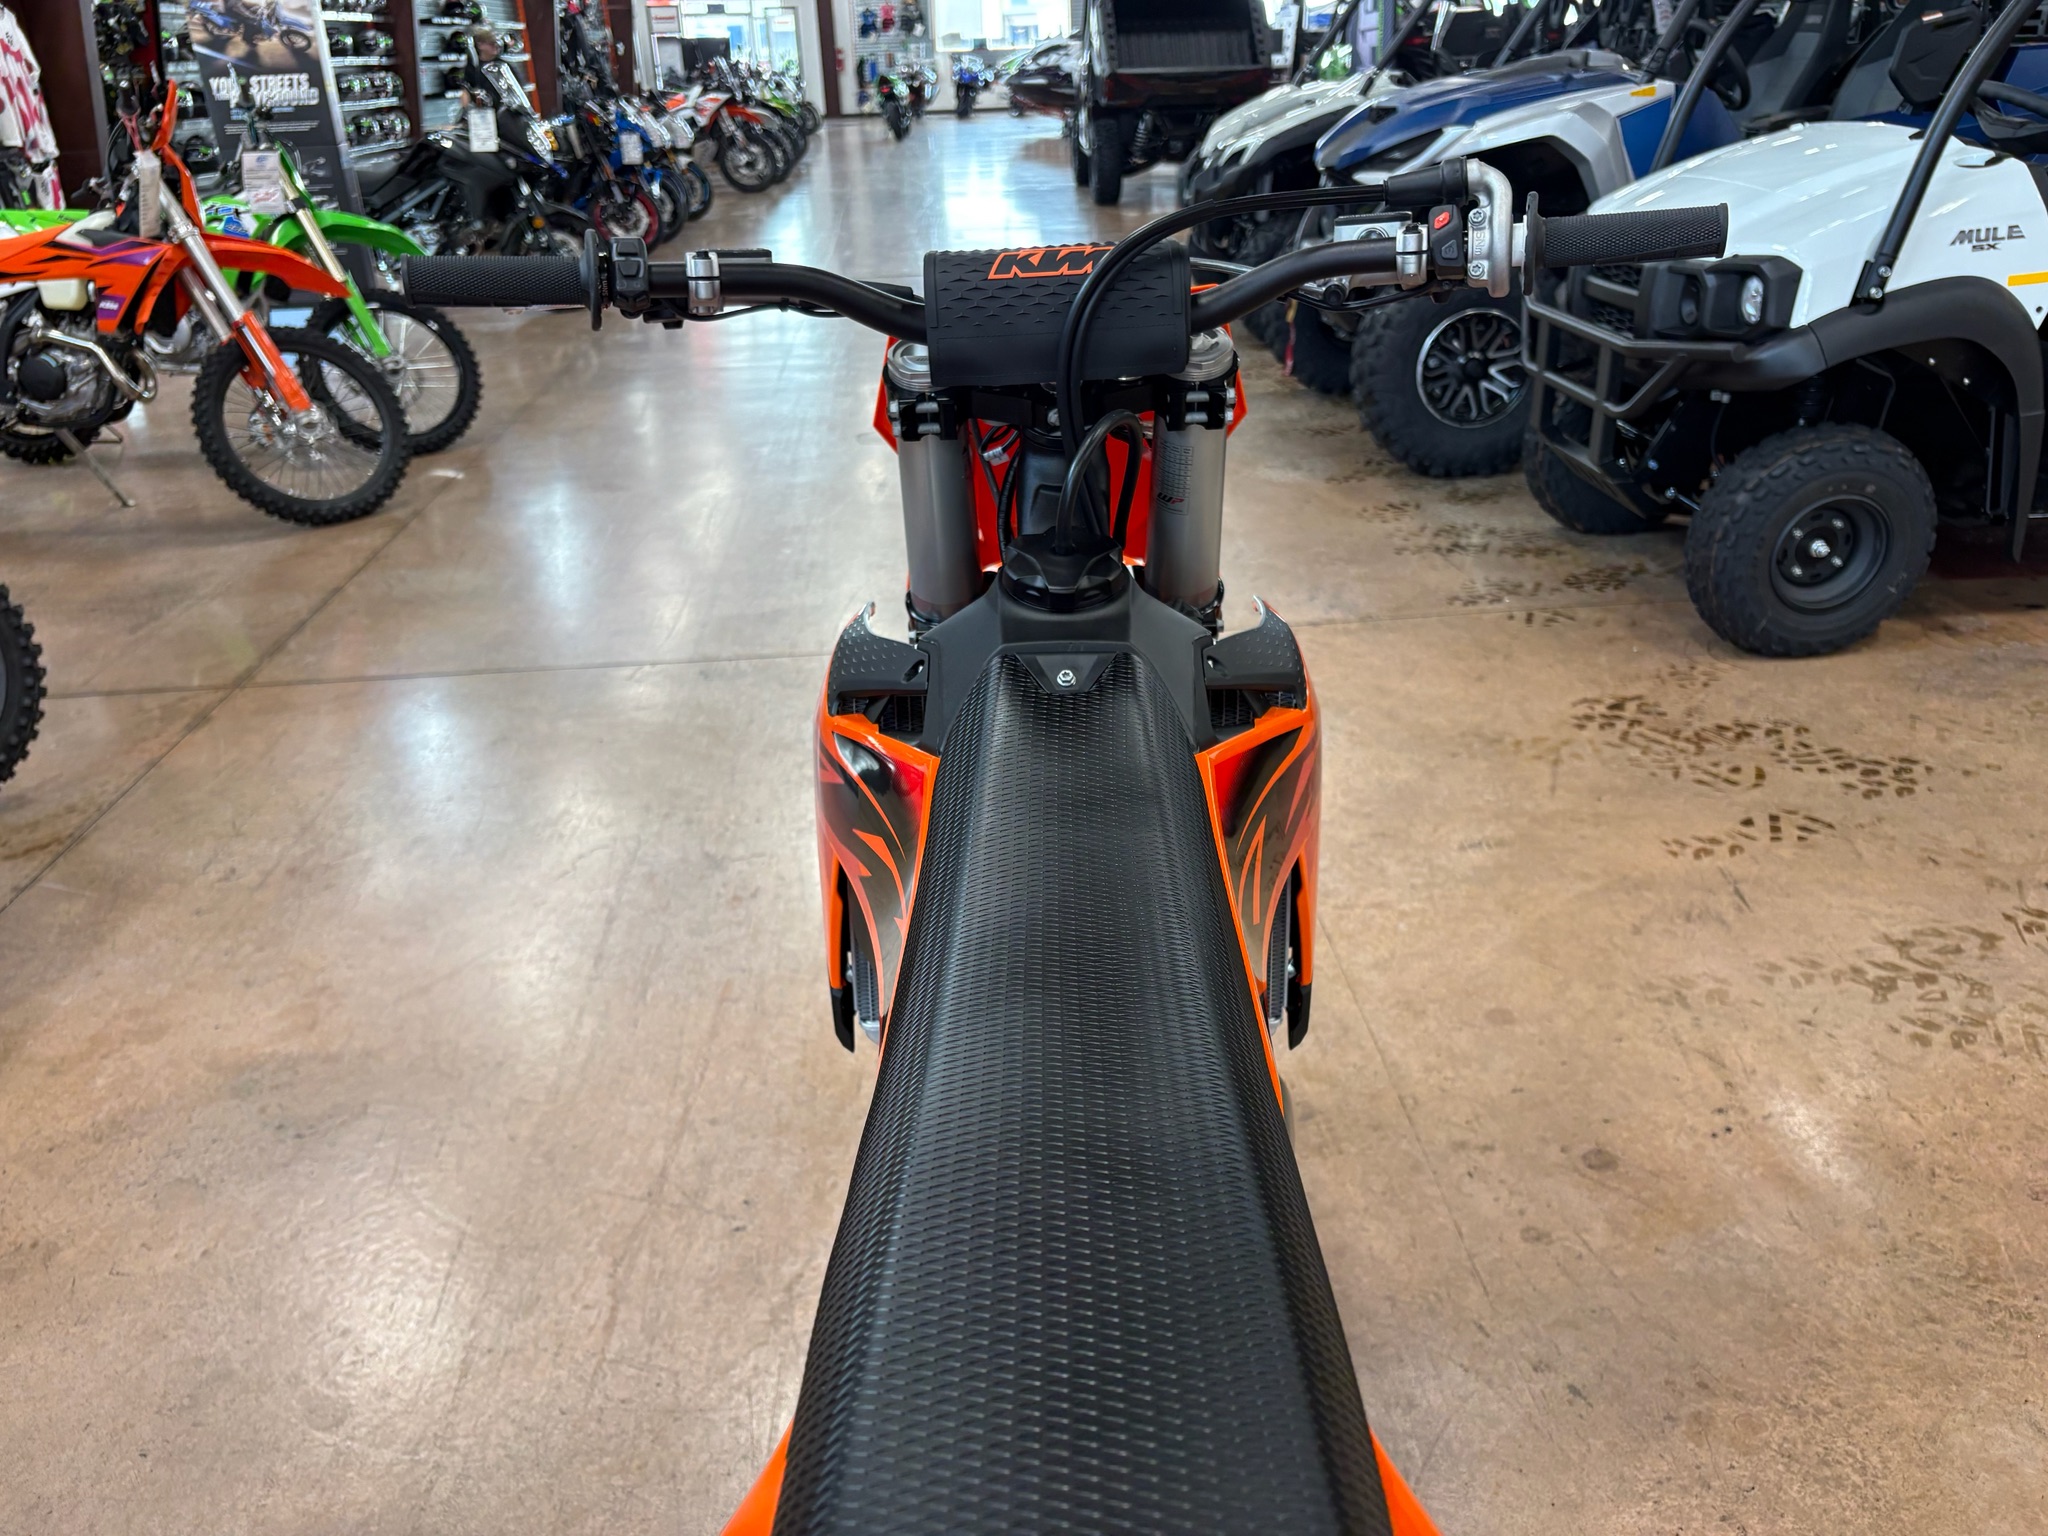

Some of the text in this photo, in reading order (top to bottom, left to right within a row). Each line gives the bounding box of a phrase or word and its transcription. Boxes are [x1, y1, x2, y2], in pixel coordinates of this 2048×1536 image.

[249, 72, 310, 92] STREETS
[1949, 225, 2026, 246] MULE
[1972, 243, 2001, 252] SX
[1157, 492, 1185, 505] WP
